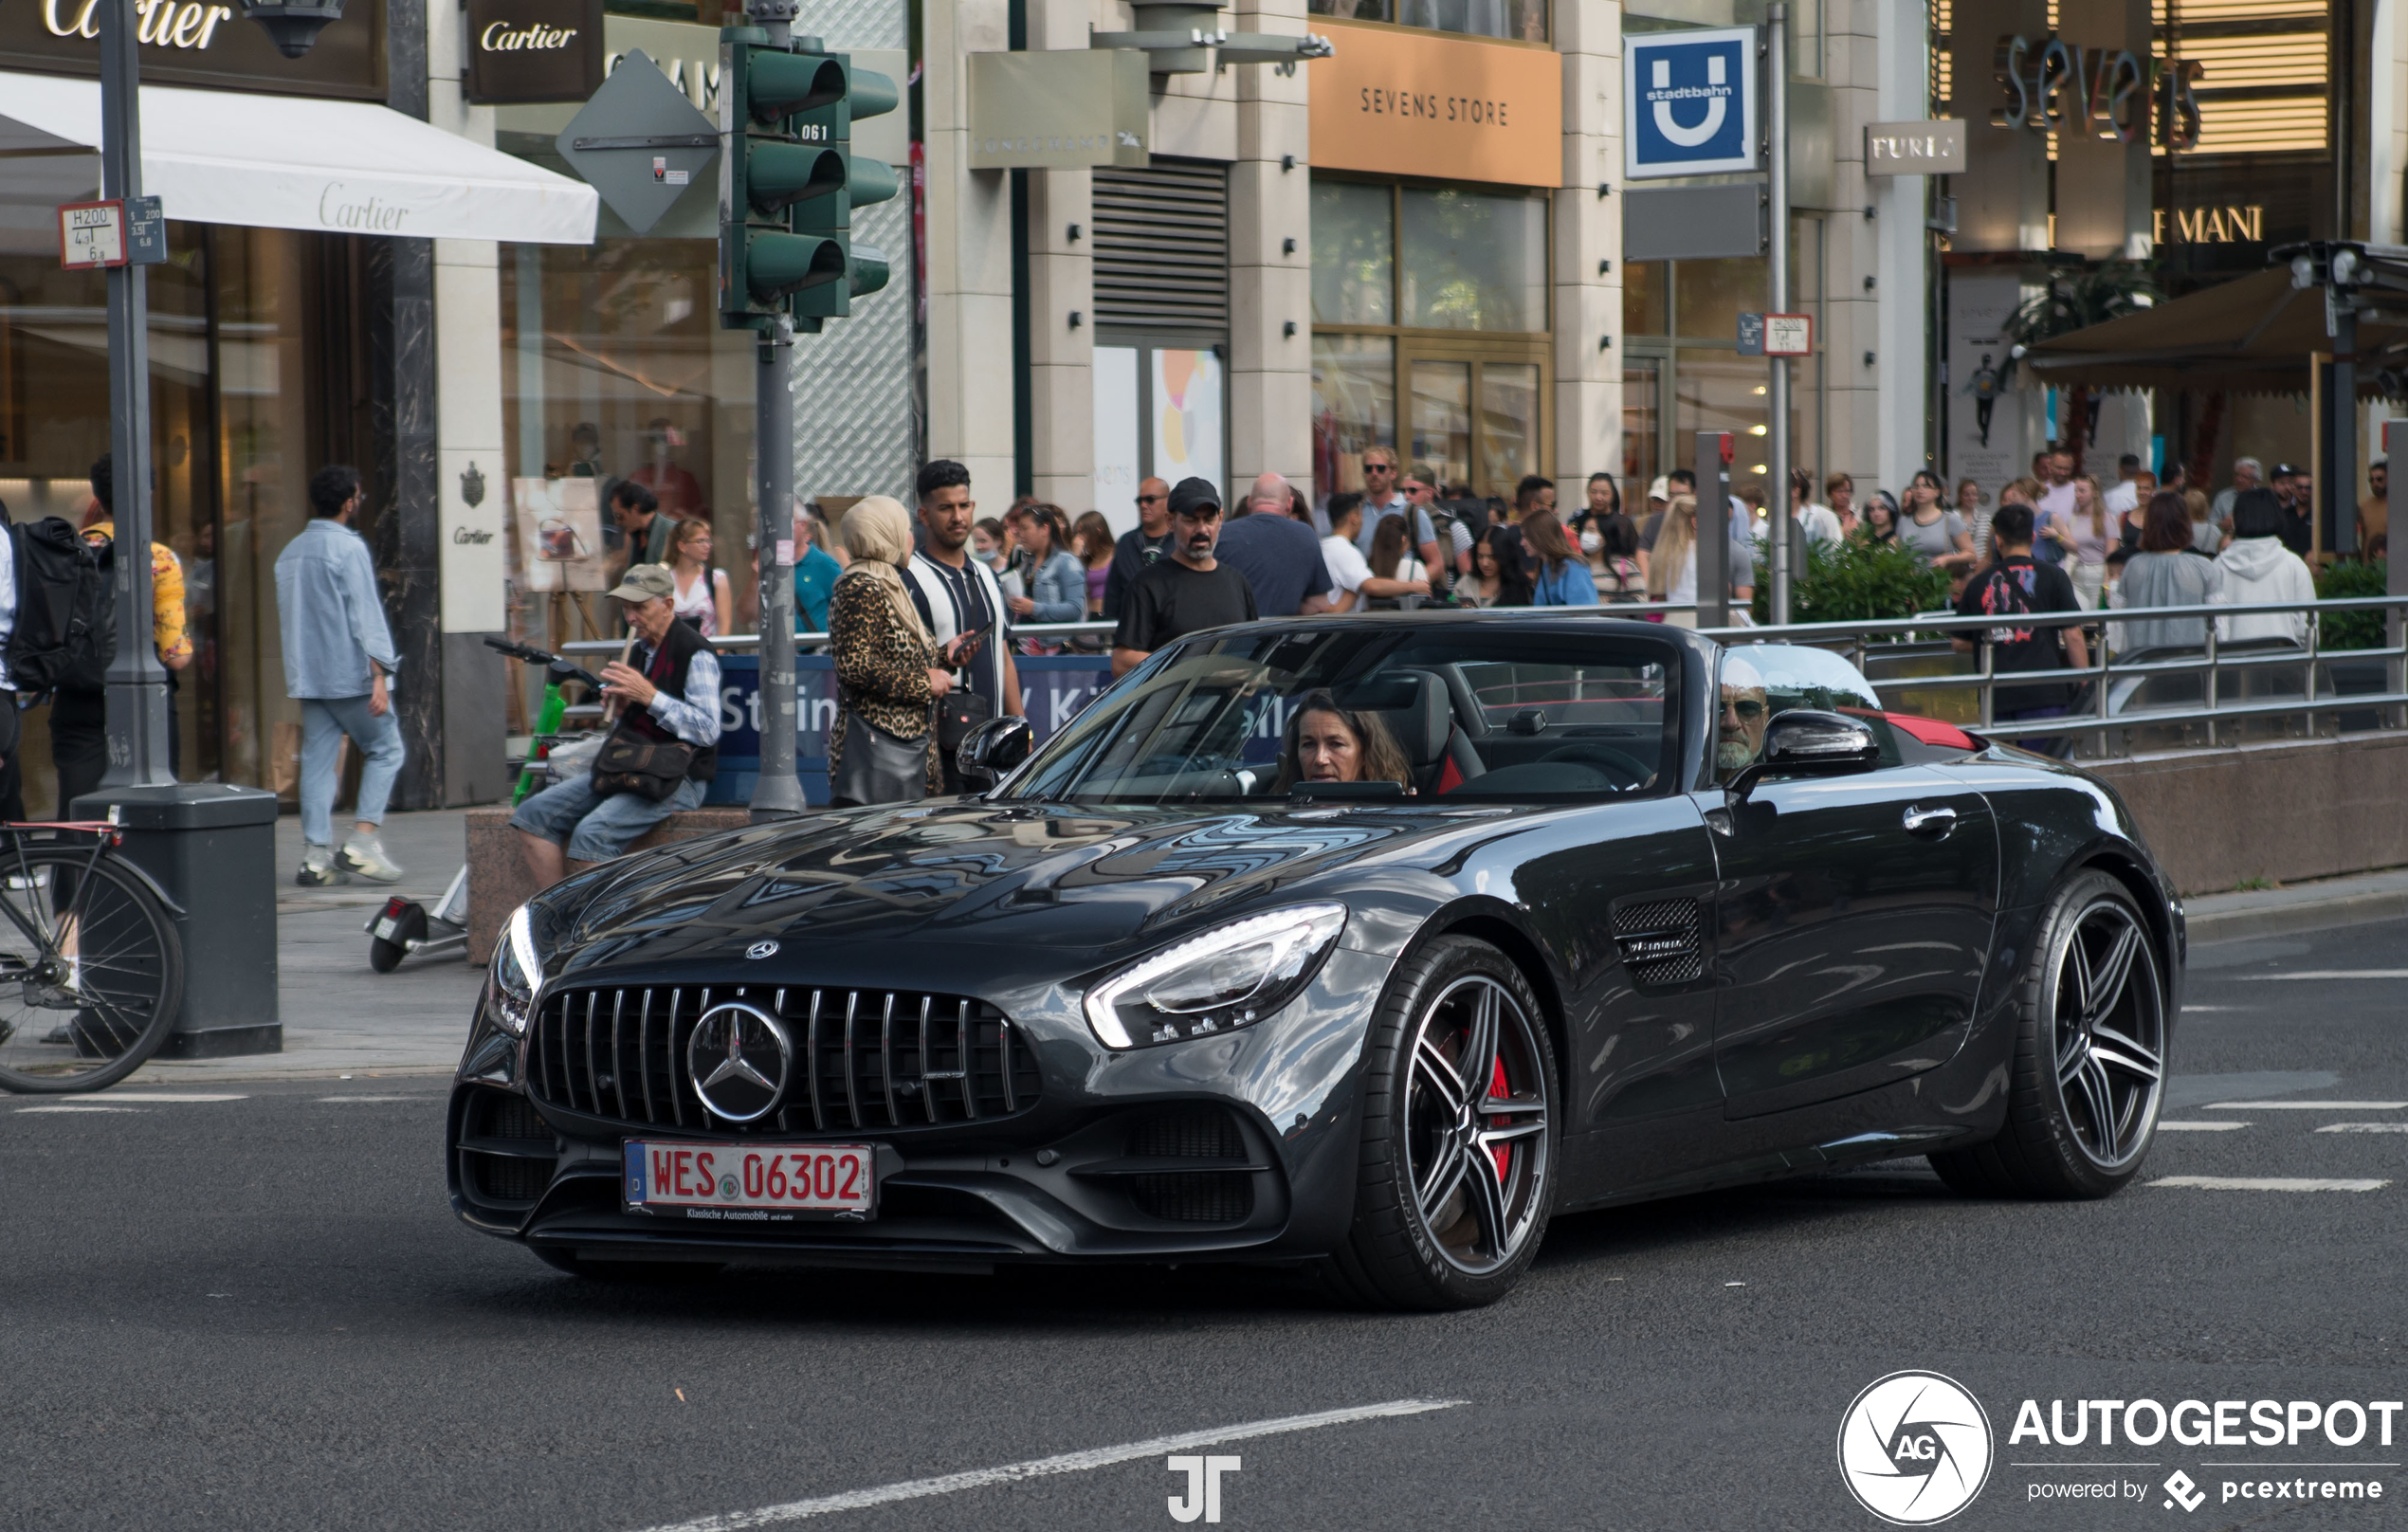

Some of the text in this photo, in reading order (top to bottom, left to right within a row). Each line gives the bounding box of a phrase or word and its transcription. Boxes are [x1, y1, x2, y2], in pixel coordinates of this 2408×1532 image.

[481, 20, 577, 51] Cartier
[1646, 85, 1732, 100] stadtbahn
[1361, 88, 1508, 126] SEVENS STORE
[802, 124, 828, 140] 061
[319, 181, 410, 230] Cartier
[73, 209, 107, 225] H200
[145, 210, 160, 219] 200
[454, 526, 494, 545] Cartier
[653, 1150, 716, 1196] WES
[744, 1154, 861, 1201] 06302
[686, 1208, 721, 1220] Klassische
[723, 1210, 769, 1221] Automobile
